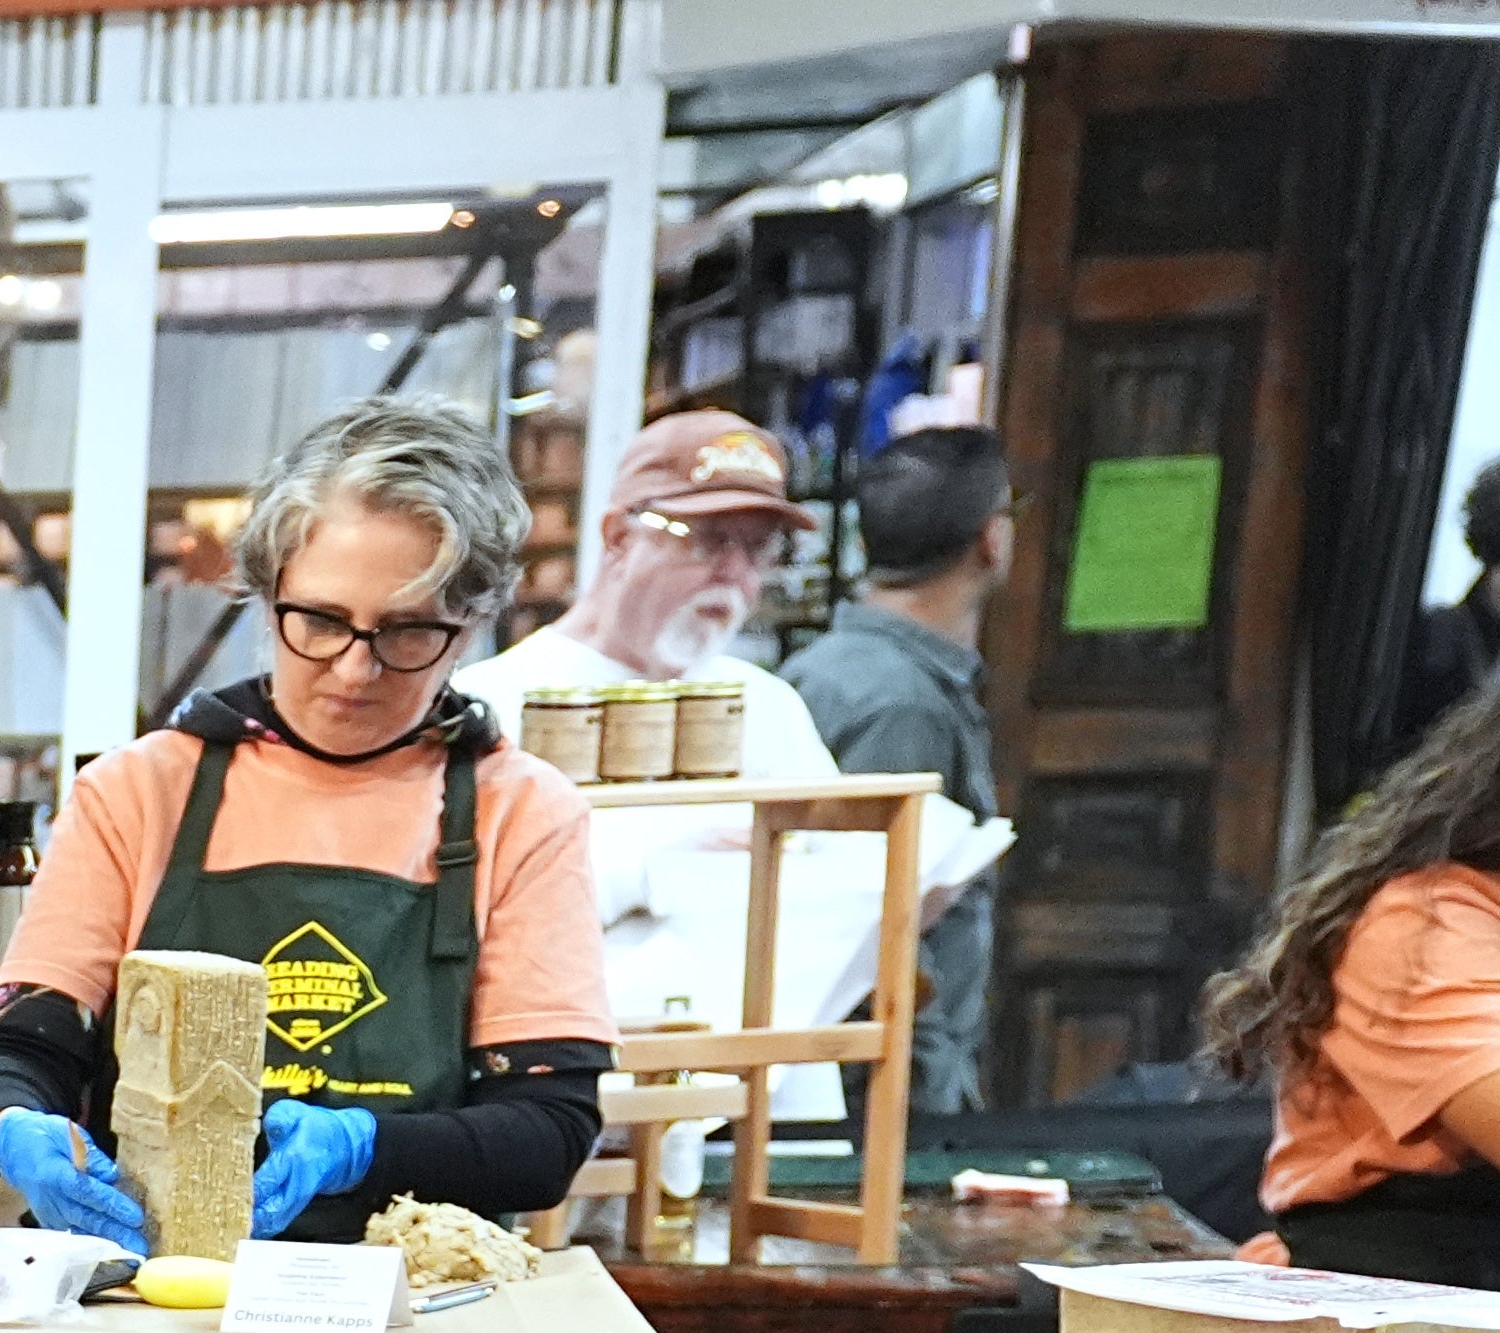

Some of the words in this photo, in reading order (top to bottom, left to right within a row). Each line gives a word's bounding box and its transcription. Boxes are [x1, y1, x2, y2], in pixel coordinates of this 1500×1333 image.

[268, 977, 364, 1000] ERMINAL
[234, 1309, 323, 1325] Christianne
[326, 1314, 373, 1329] Kapps
